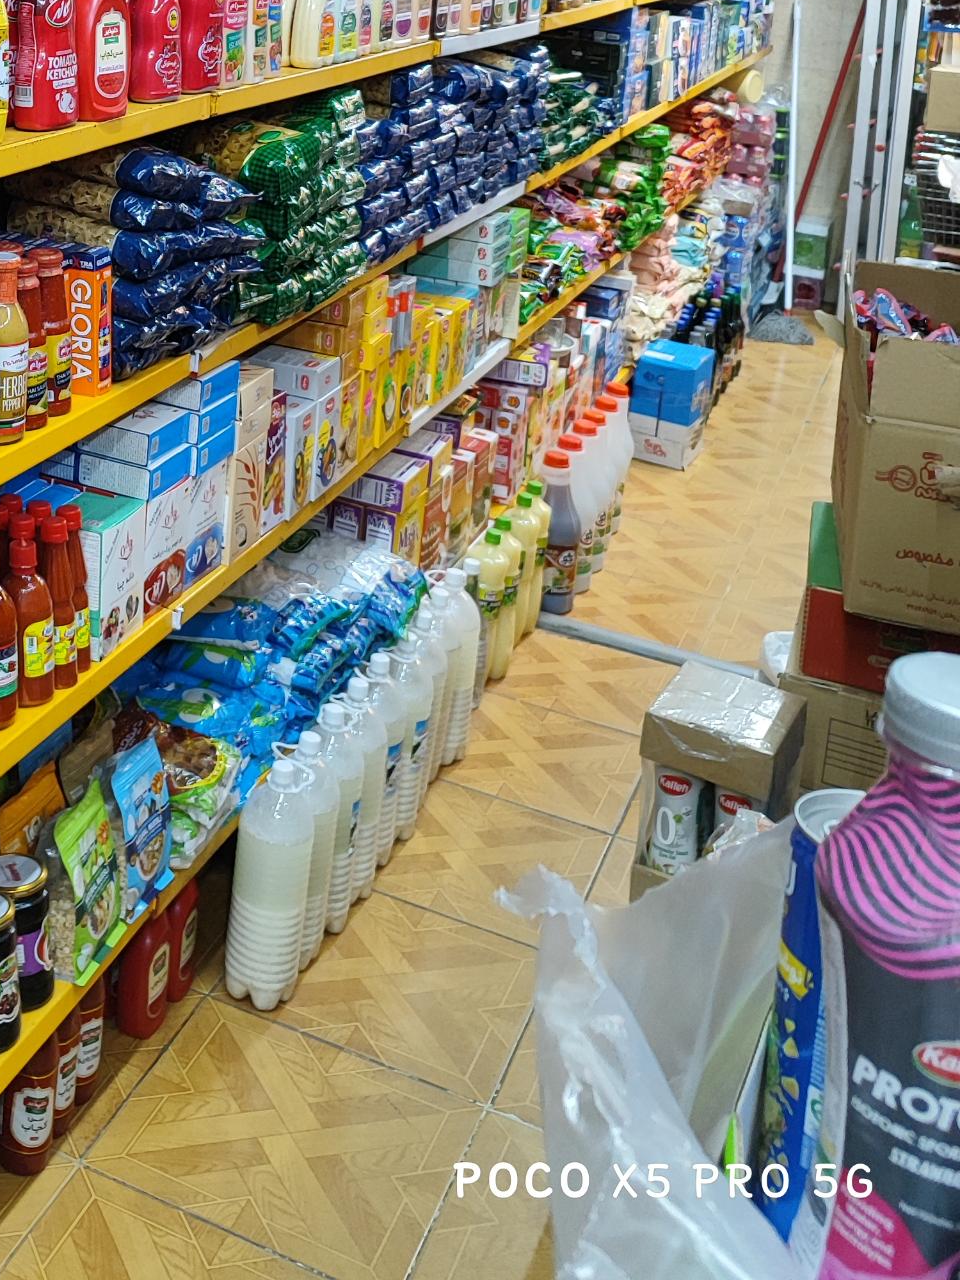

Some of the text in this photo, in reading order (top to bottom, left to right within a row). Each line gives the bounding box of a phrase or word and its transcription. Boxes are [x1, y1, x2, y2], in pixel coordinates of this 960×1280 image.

[47, 53, 77, 69] TOMATO
[46, 65, 78, 81] KETCHUP
[70, 278, 93, 381] GLORIA
[659, 776, 690, 793] Kalleh
